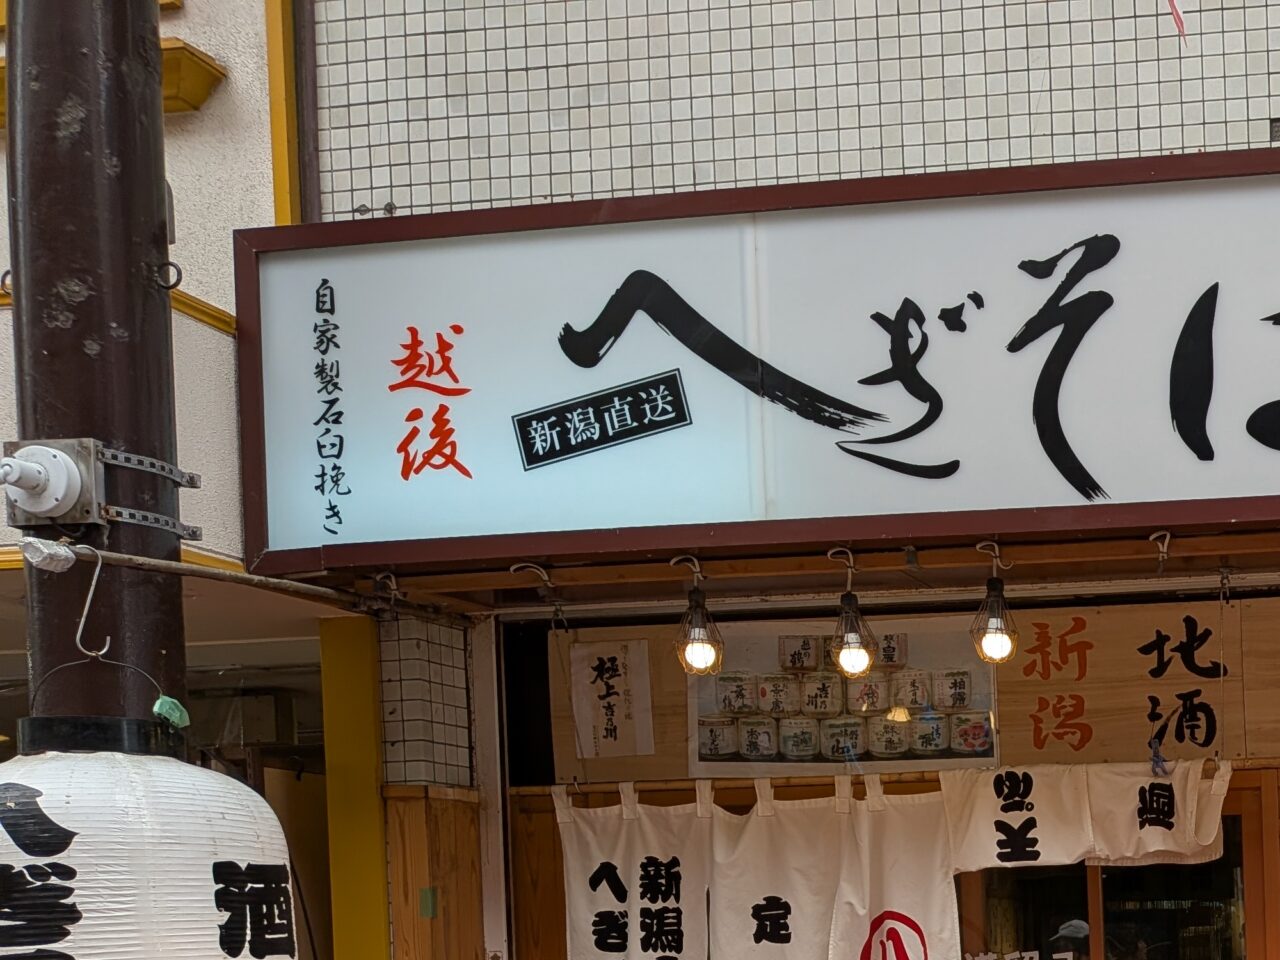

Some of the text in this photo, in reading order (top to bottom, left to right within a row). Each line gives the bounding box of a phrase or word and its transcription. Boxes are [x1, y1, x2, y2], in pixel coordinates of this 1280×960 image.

[312, 279, 351, 535] 自家製石臼挽き
[388, 324, 473, 481] 越後
[526, 384, 679, 456] 新潟直送
[1022, 616, 1094, 751] 新潟
[1136, 614, 1228, 749] 地酒
